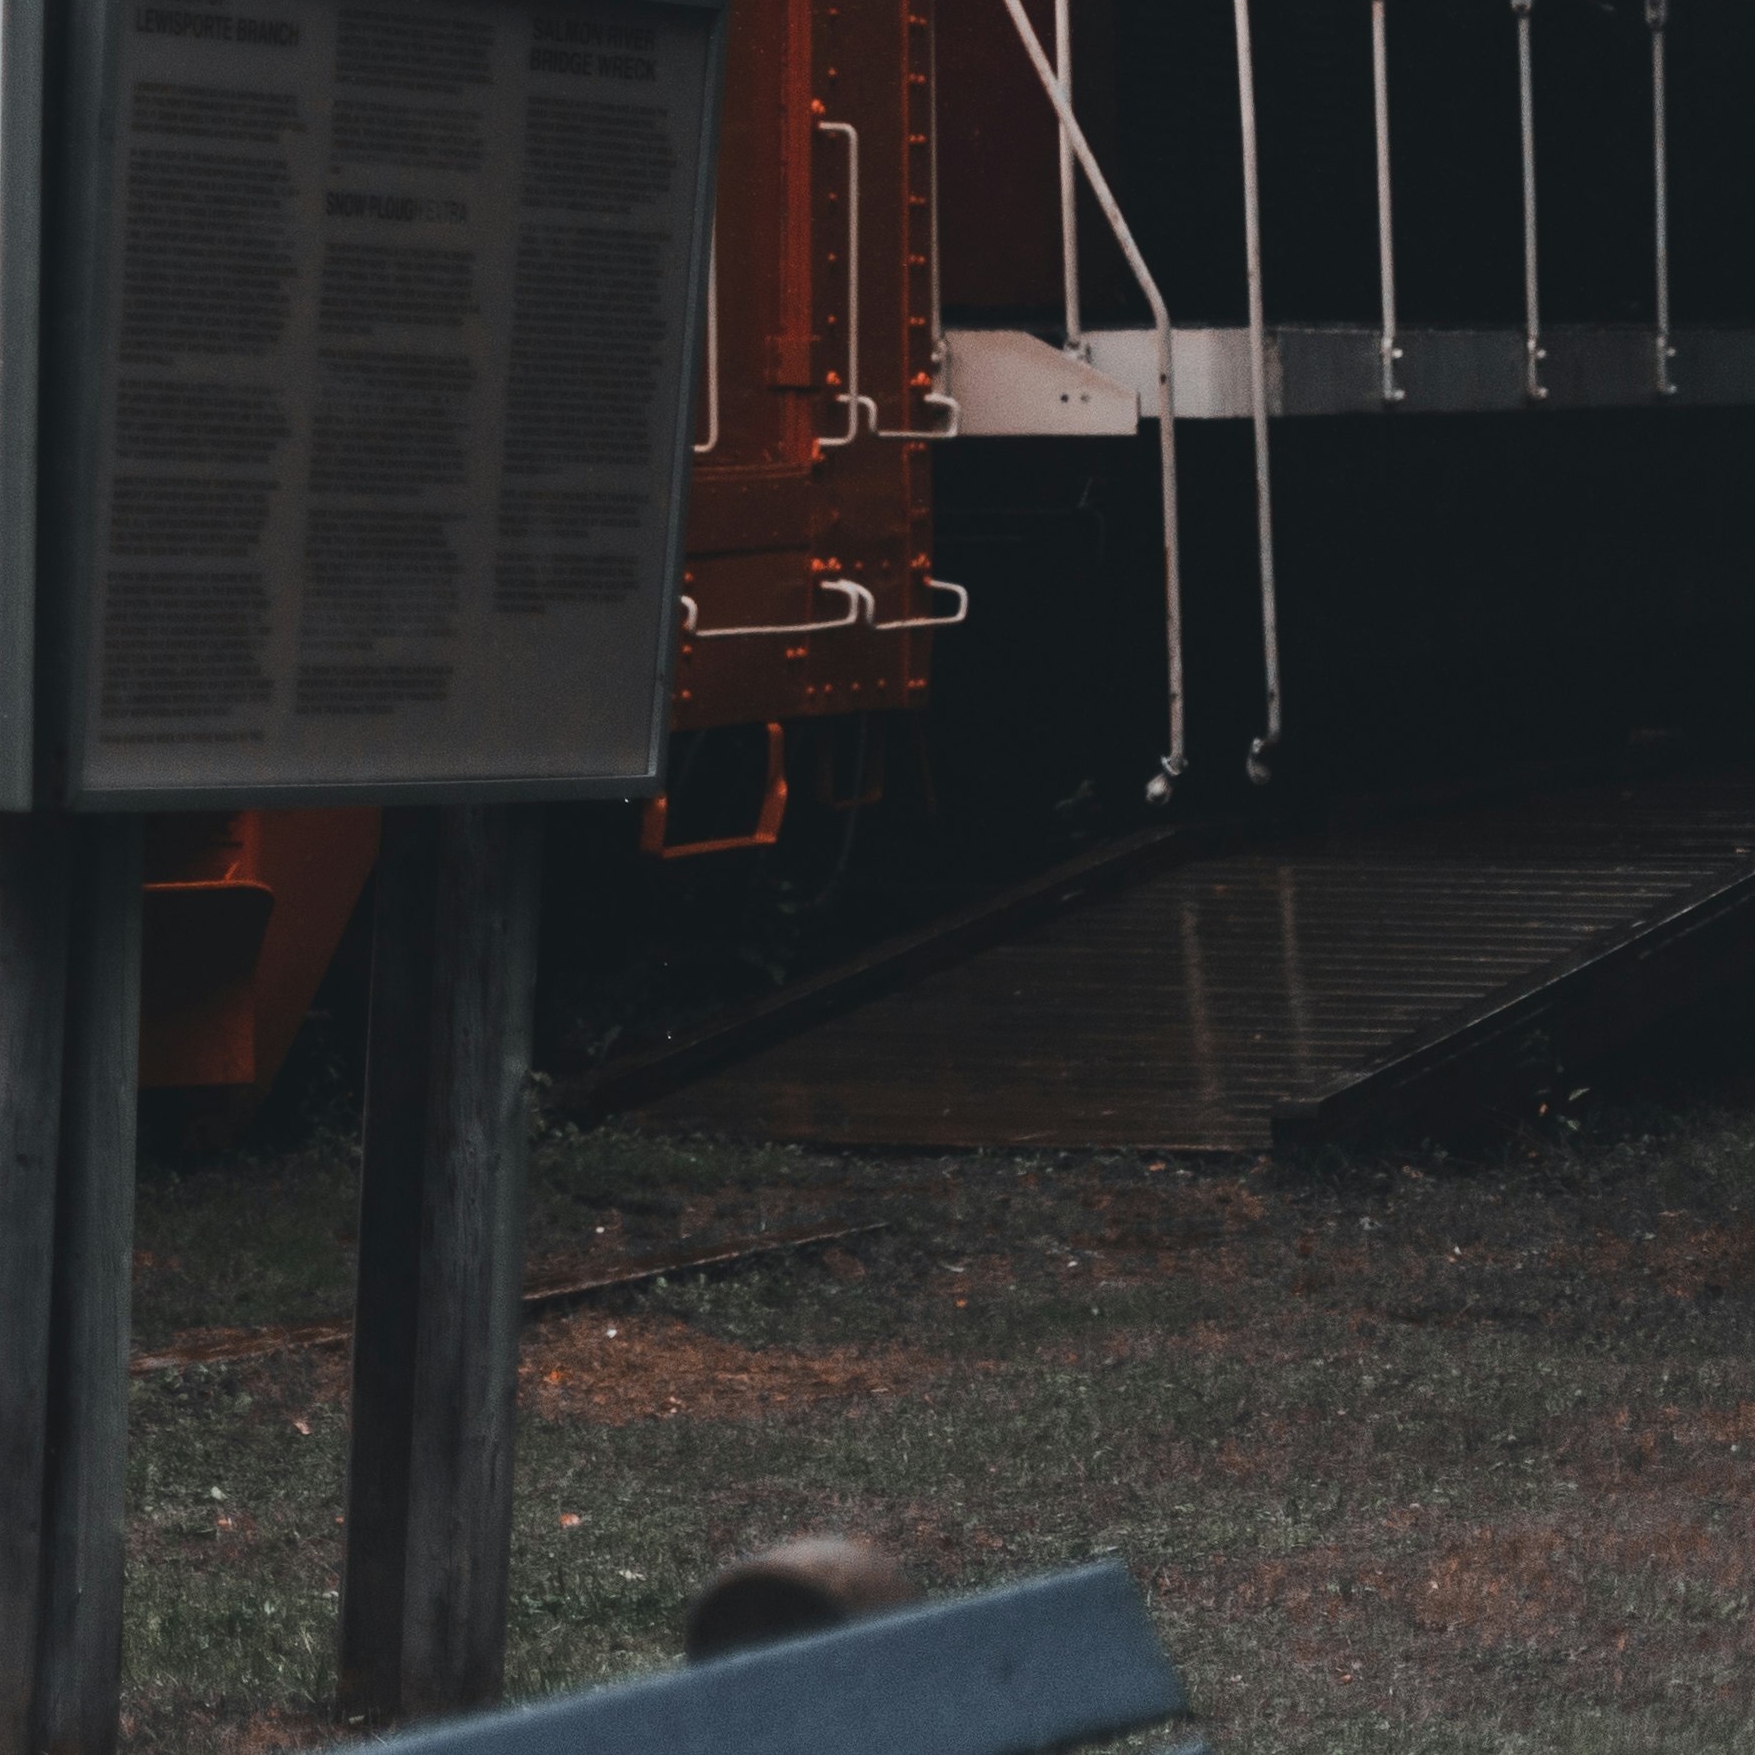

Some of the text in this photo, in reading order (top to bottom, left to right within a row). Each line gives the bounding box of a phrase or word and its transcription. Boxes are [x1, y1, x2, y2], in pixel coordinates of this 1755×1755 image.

[136, 8, 301, 47] LEWISPORTE BRANCH
[532, 16, 656, 52] SALMON RIVER
[529, 46, 657, 83] BRIDGE WRECK
[326, 191, 467, 223] SNOW PLOUGH EXTRA
